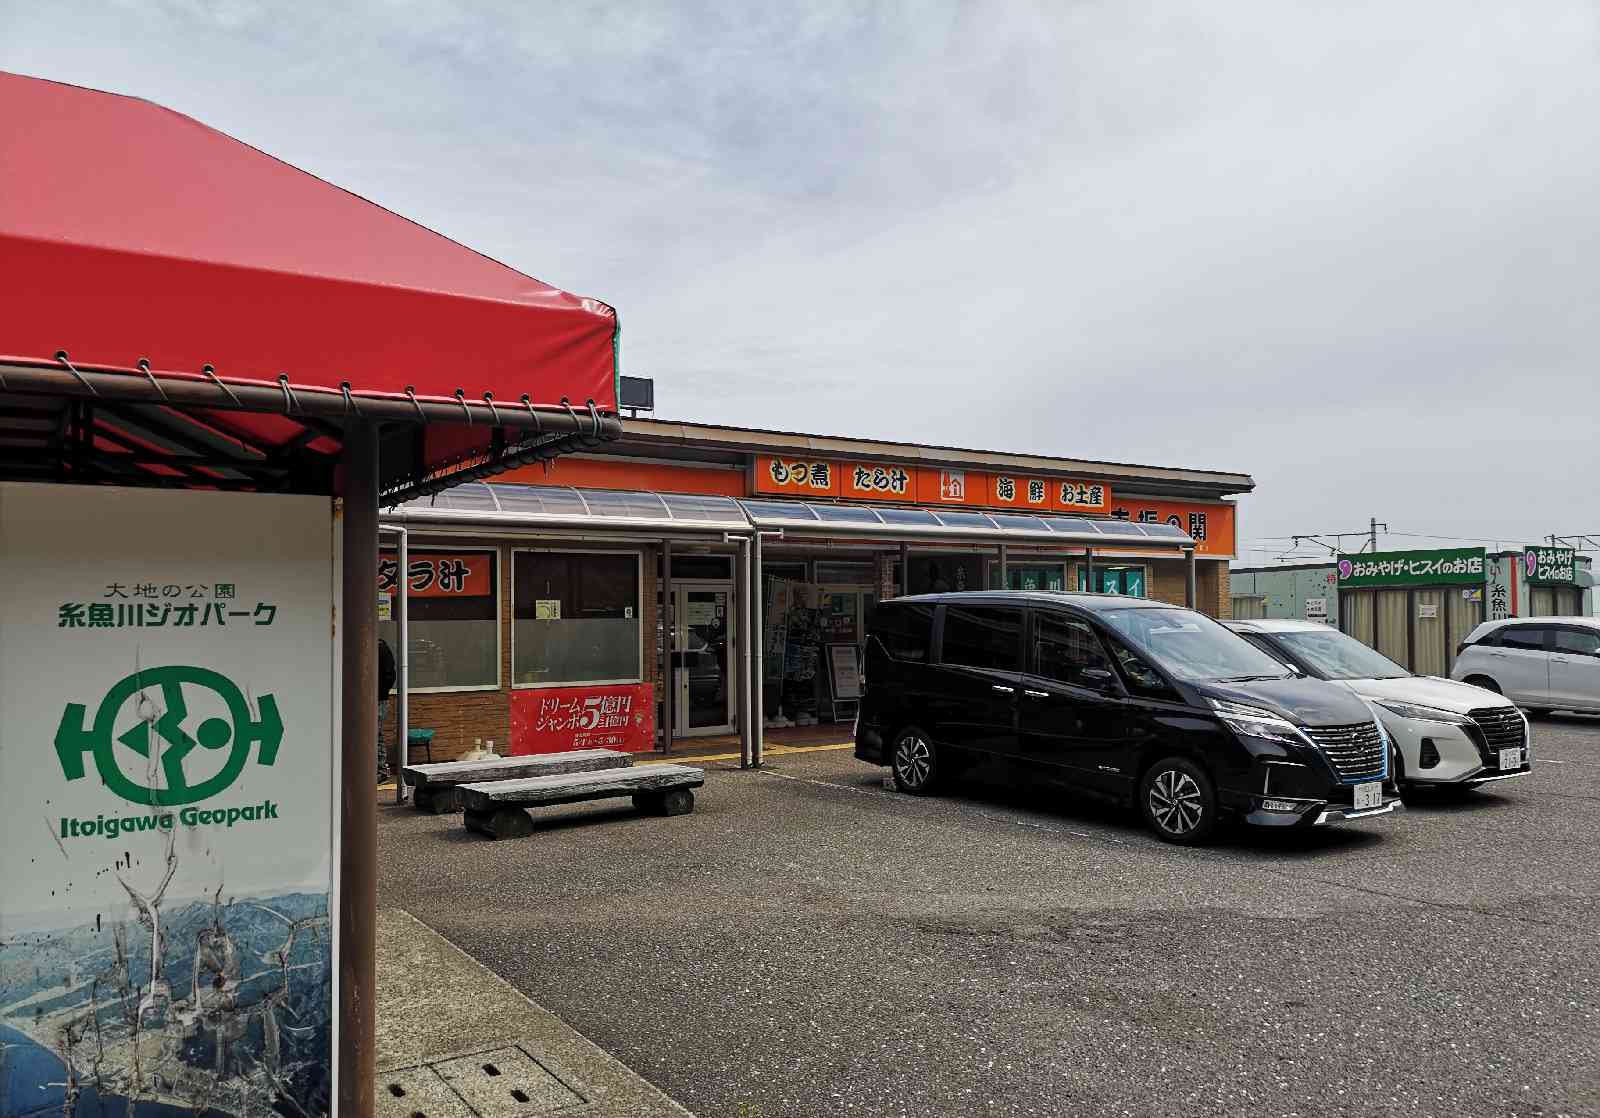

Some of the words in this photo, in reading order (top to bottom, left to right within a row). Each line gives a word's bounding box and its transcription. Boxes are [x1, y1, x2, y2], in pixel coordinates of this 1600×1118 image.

[771, 459, 831, 489] もつ煮
[854, 467, 909, 493] たら汁
[1060, 482, 1105, 507] お土産
[1353, 557, 1483, 577] おみやげ・ヒスイのお店
[1537, 550, 1573, 565] おみやげ
[1538, 566, 1573, 581] ヒスイのお店
[103, 582, 236, 599] 大地の公園
[58, 602, 277, 628] 糸魚川ジオパーク
[541, 697, 580, 715] ドリーム
[60, 810, 174, 839] Itoigawa
[179, 800, 278, 827] Geopark
